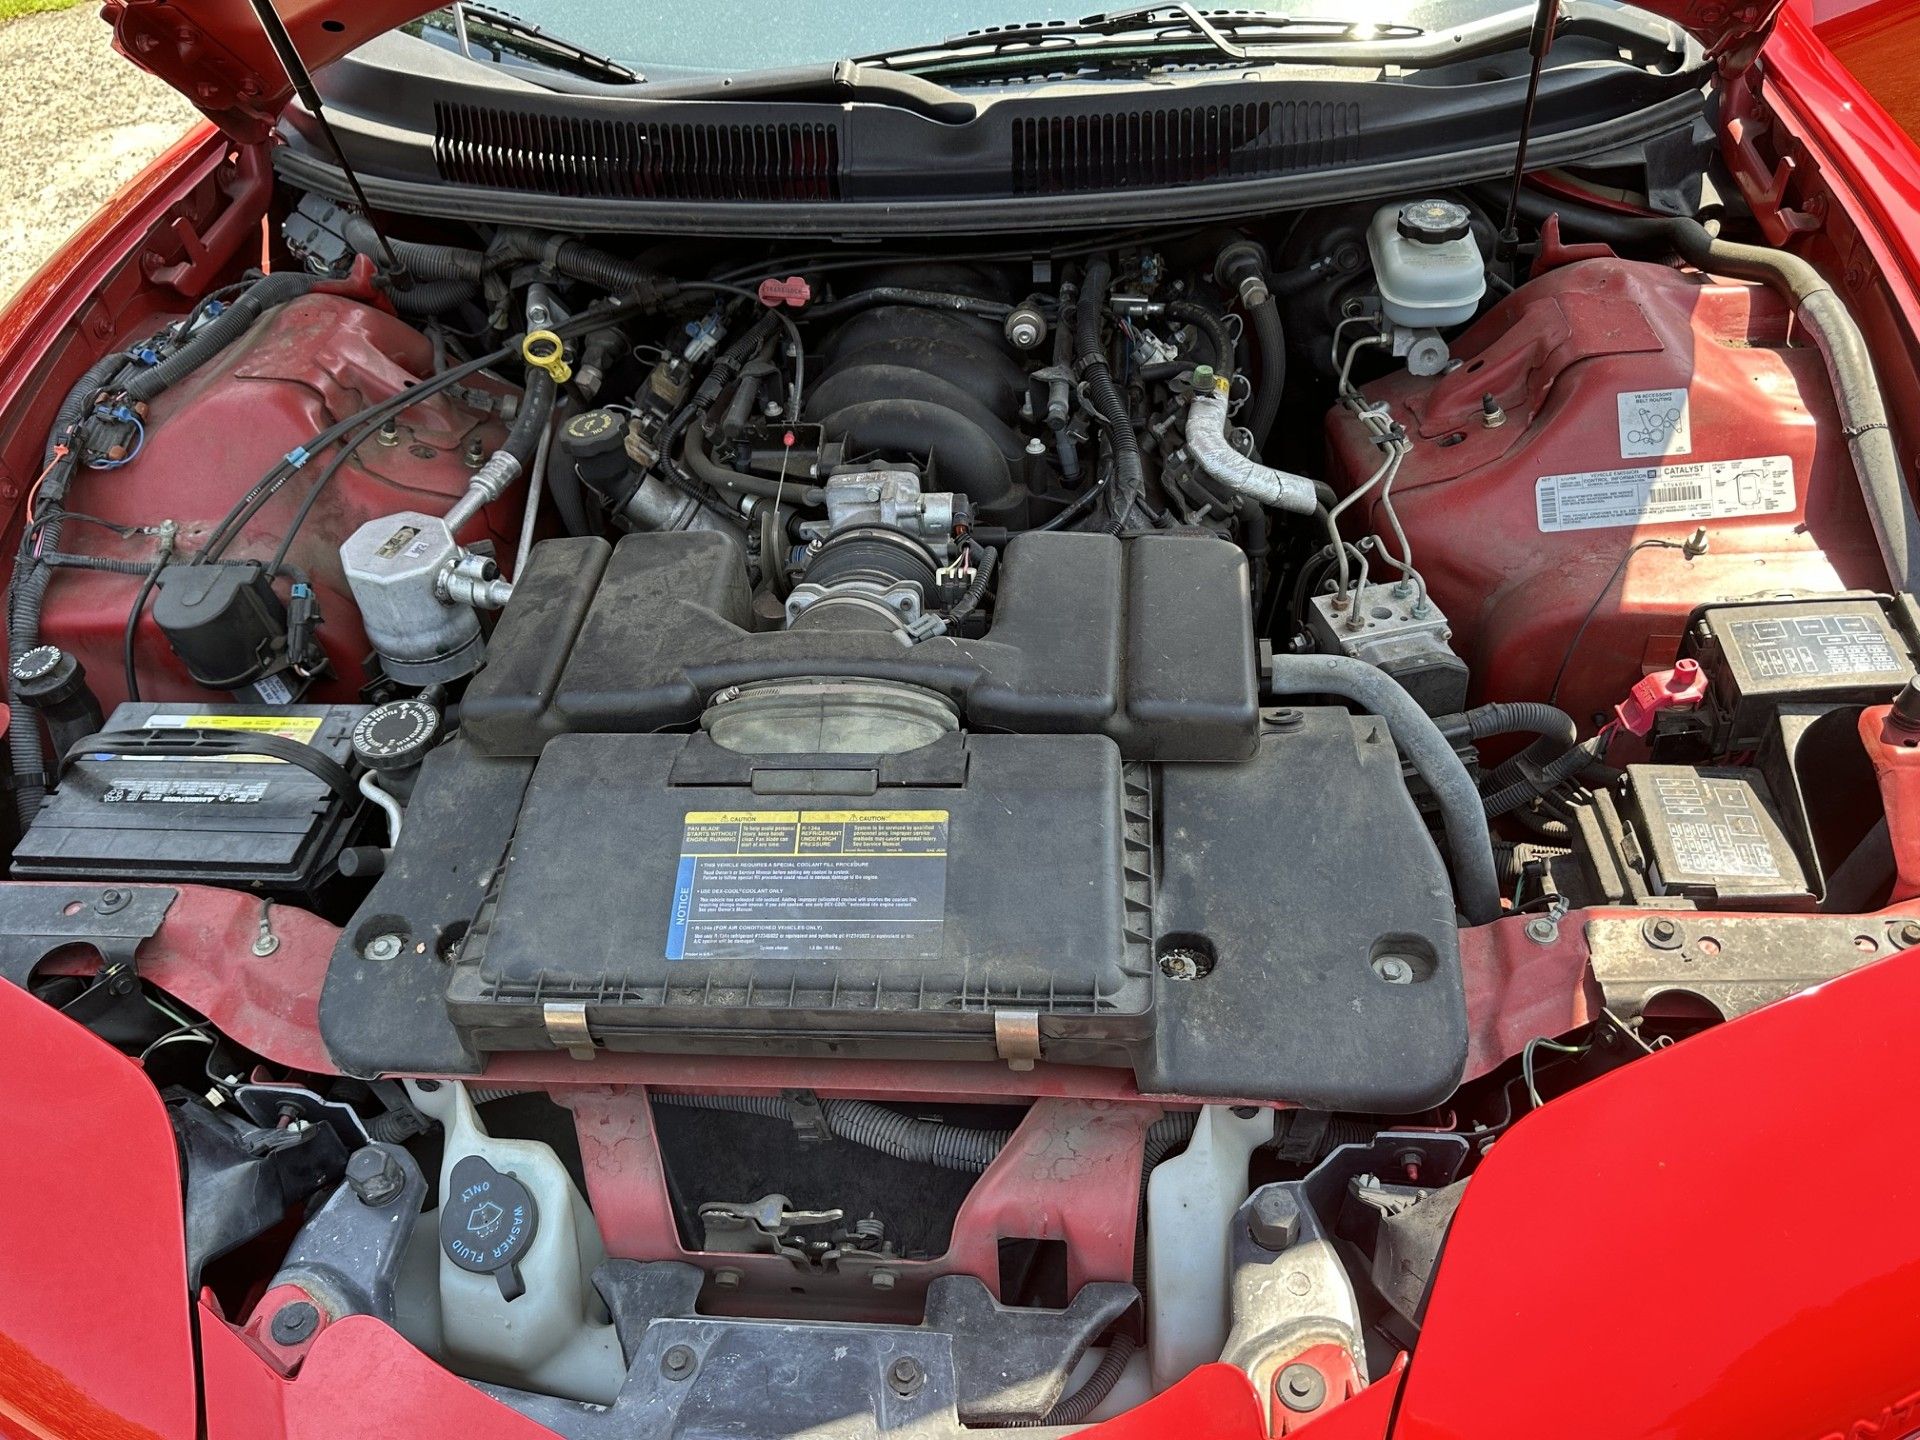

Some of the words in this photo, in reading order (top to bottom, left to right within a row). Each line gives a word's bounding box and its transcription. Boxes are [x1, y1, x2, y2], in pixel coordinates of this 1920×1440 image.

[1664, 465, 1704, 475] CATALYST
[13, 645, 48, 667] ENGINE
[36, 645, 61, 675] COOLANT
[12, 668, 32, 677] ONLY
[370, 706, 388, 718] HOT
[355, 718, 372, 734] OPEN
[354, 734, 372, 752] NEVER
[676, 887, 689, 925] NOTICE
[461, 1181, 490, 1202] ONLY
[492, 1206, 523, 1258] WASHER
[452, 1240, 484, 1262] FLUID
